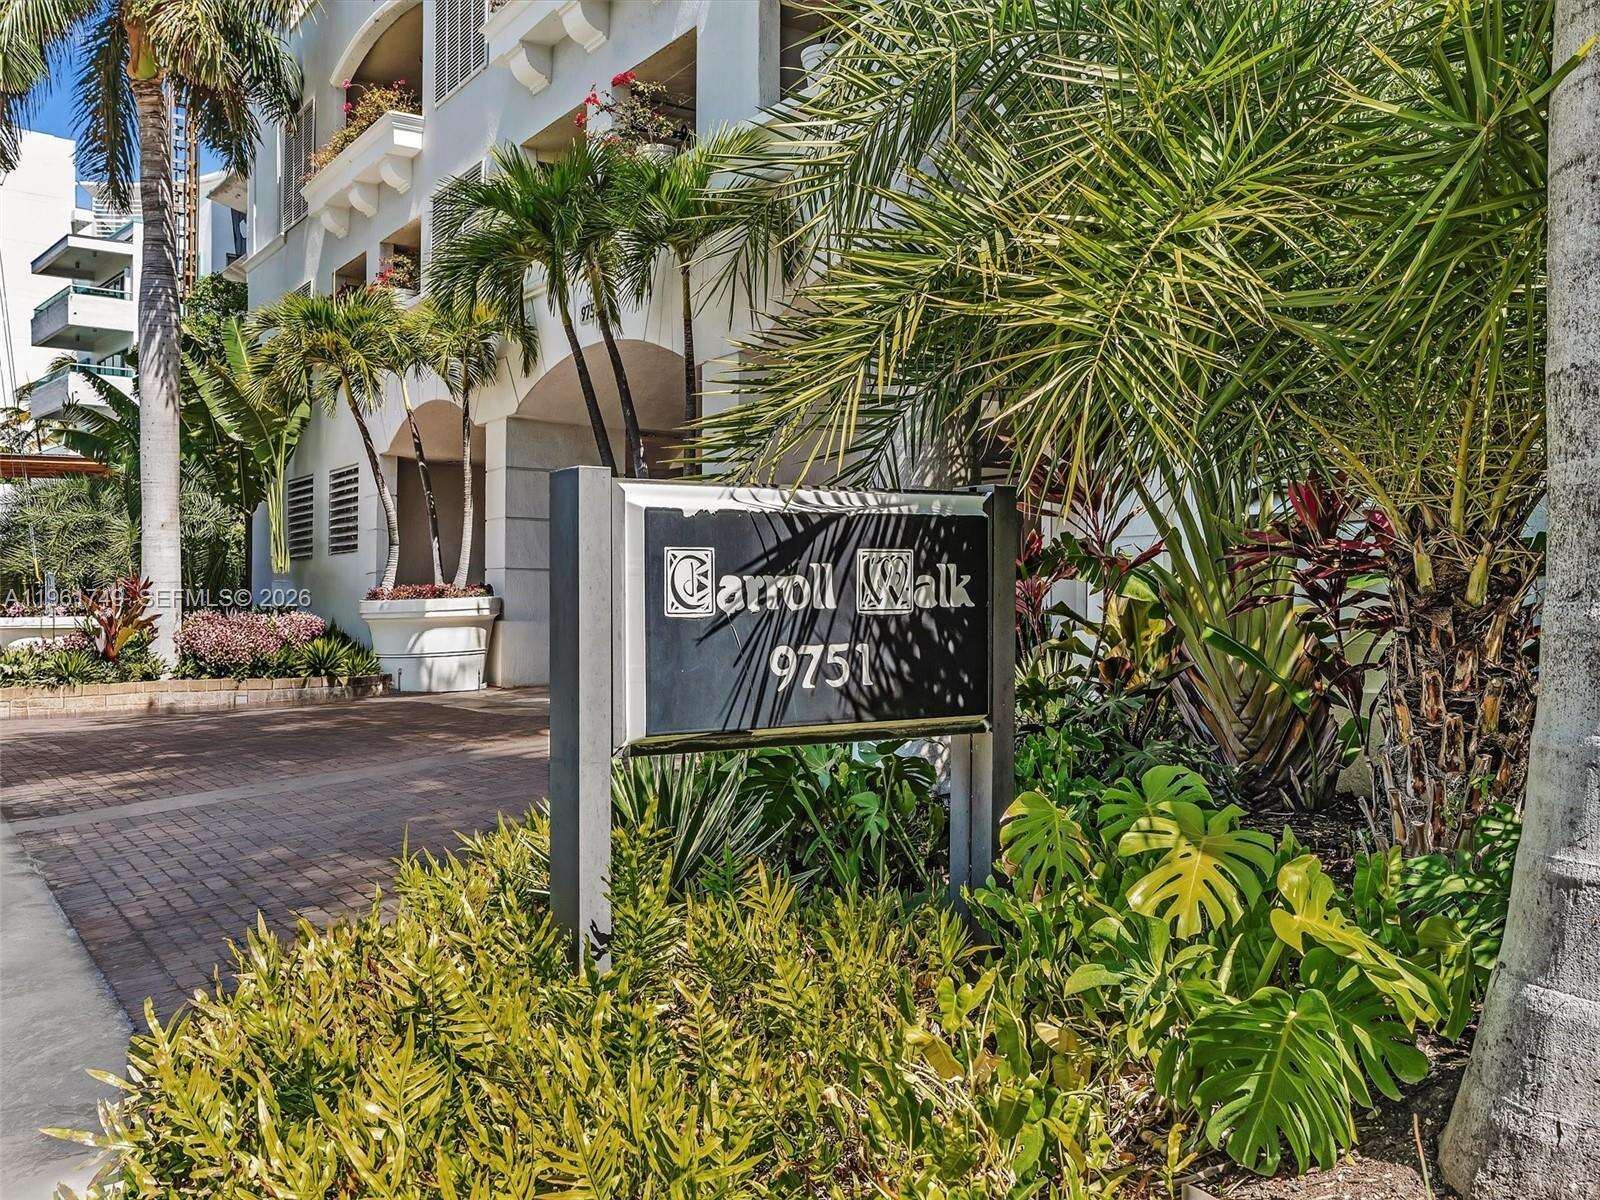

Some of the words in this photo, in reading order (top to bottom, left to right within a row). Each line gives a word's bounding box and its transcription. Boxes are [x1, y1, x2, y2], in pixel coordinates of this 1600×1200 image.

[581, 303, 596, 322] 975
[664, 547, 837, 618] Carroll
[857, 548, 976, 615] Walk
[770, 643, 874, 692] 9751
